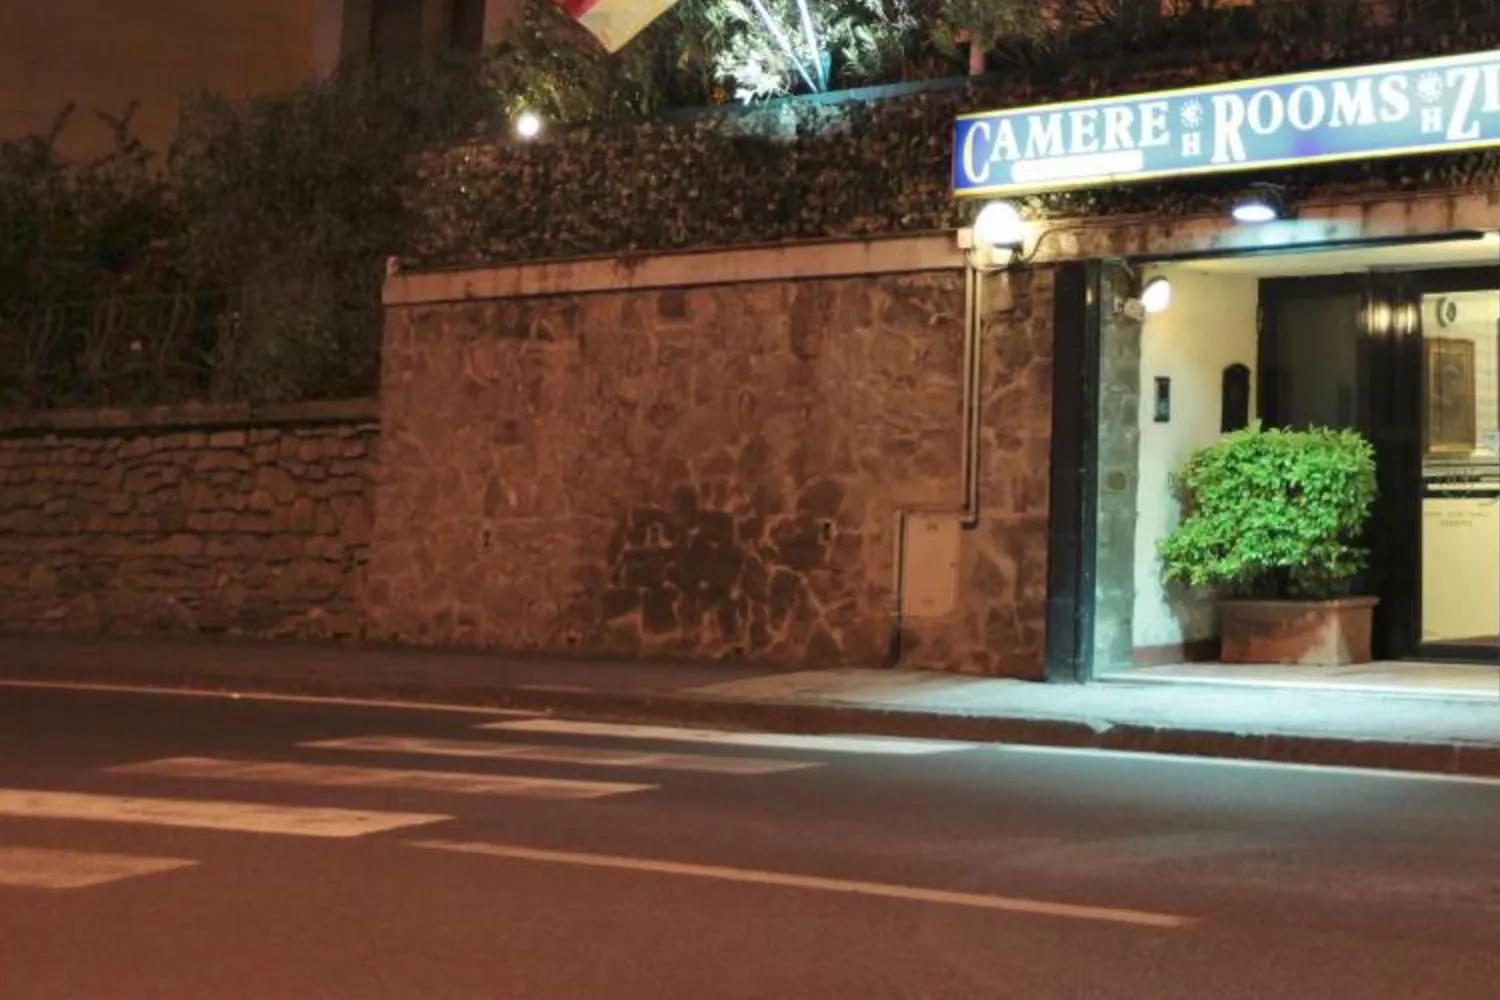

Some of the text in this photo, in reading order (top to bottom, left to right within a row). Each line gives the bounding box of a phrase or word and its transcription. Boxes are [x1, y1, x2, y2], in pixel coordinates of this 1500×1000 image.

[963, 101, 1171, 183] CAMERE
[1181, 131, 1201, 158] H
[1210, 74, 1410, 165] ROOMS
[1420, 106, 1443, 135] H
